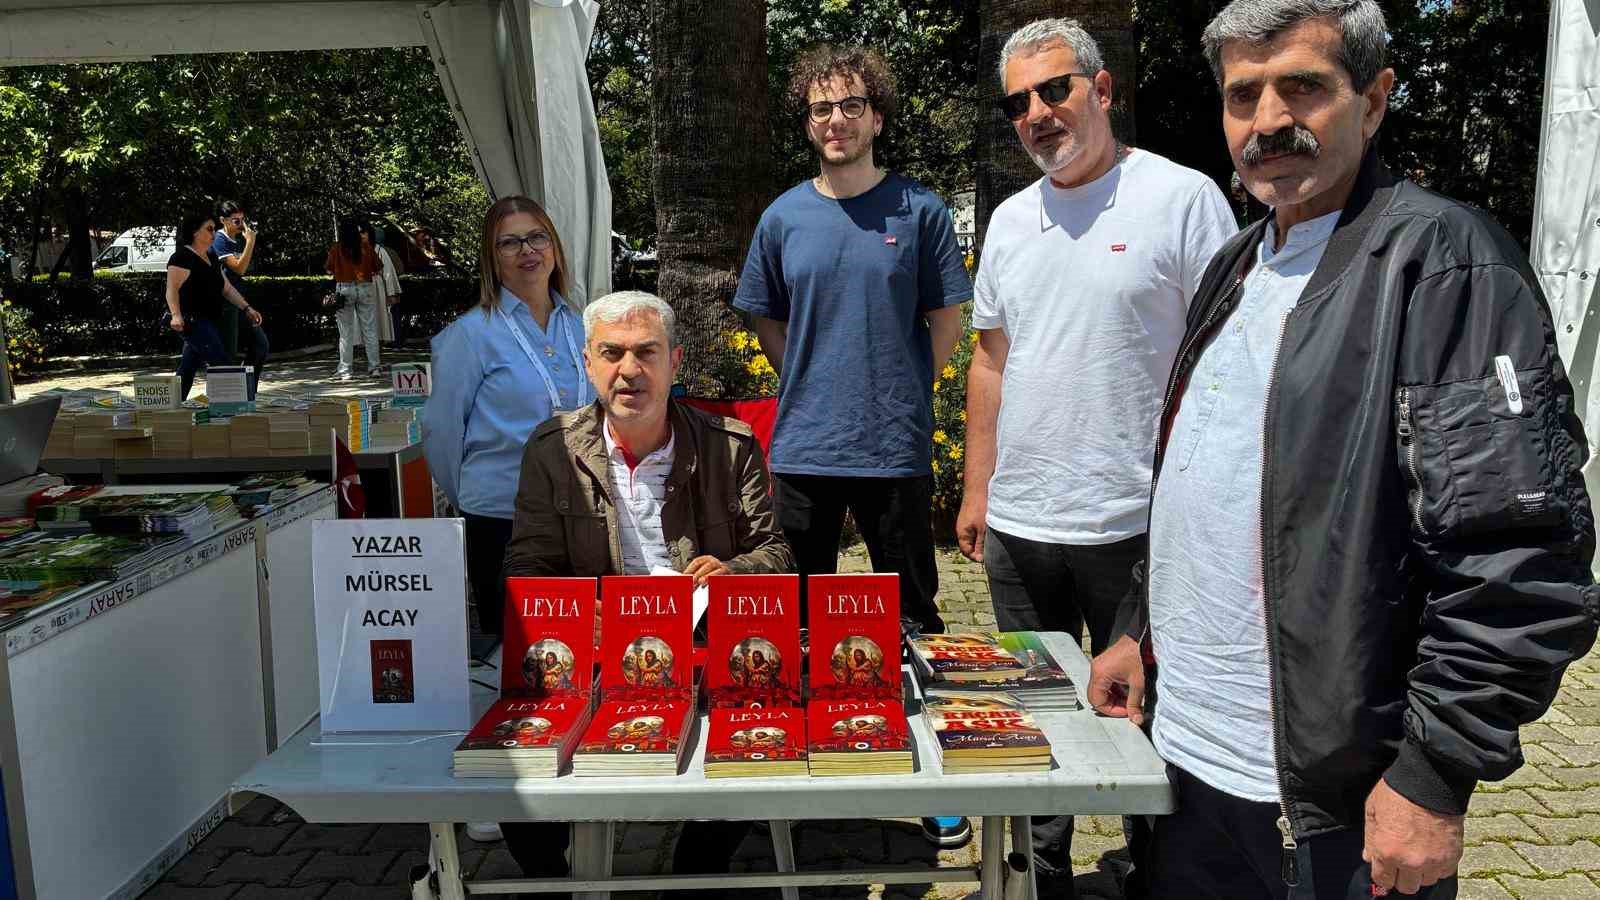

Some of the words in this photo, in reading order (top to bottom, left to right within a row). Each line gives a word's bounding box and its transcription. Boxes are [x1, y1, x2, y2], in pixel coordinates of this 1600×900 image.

[223, 527, 256, 553] SARAY
[352, 536, 422, 554] YAZAR
[346, 571, 433, 592] MÜRSEL
[88, 582, 135, 617] SARAY
[523, 598, 580, 617] LEYLA
[620, 595, 677, 616] LEYLA
[727, 596, 785, 616] LEYLA
[827, 594, 886, 615] LEYLA
[362, 609, 418, 627] ACAY
[616, 702, 675, 714] LEYLA
[729, 711, 791, 723] LEYLA
[827, 702, 887, 713] LEYLA
